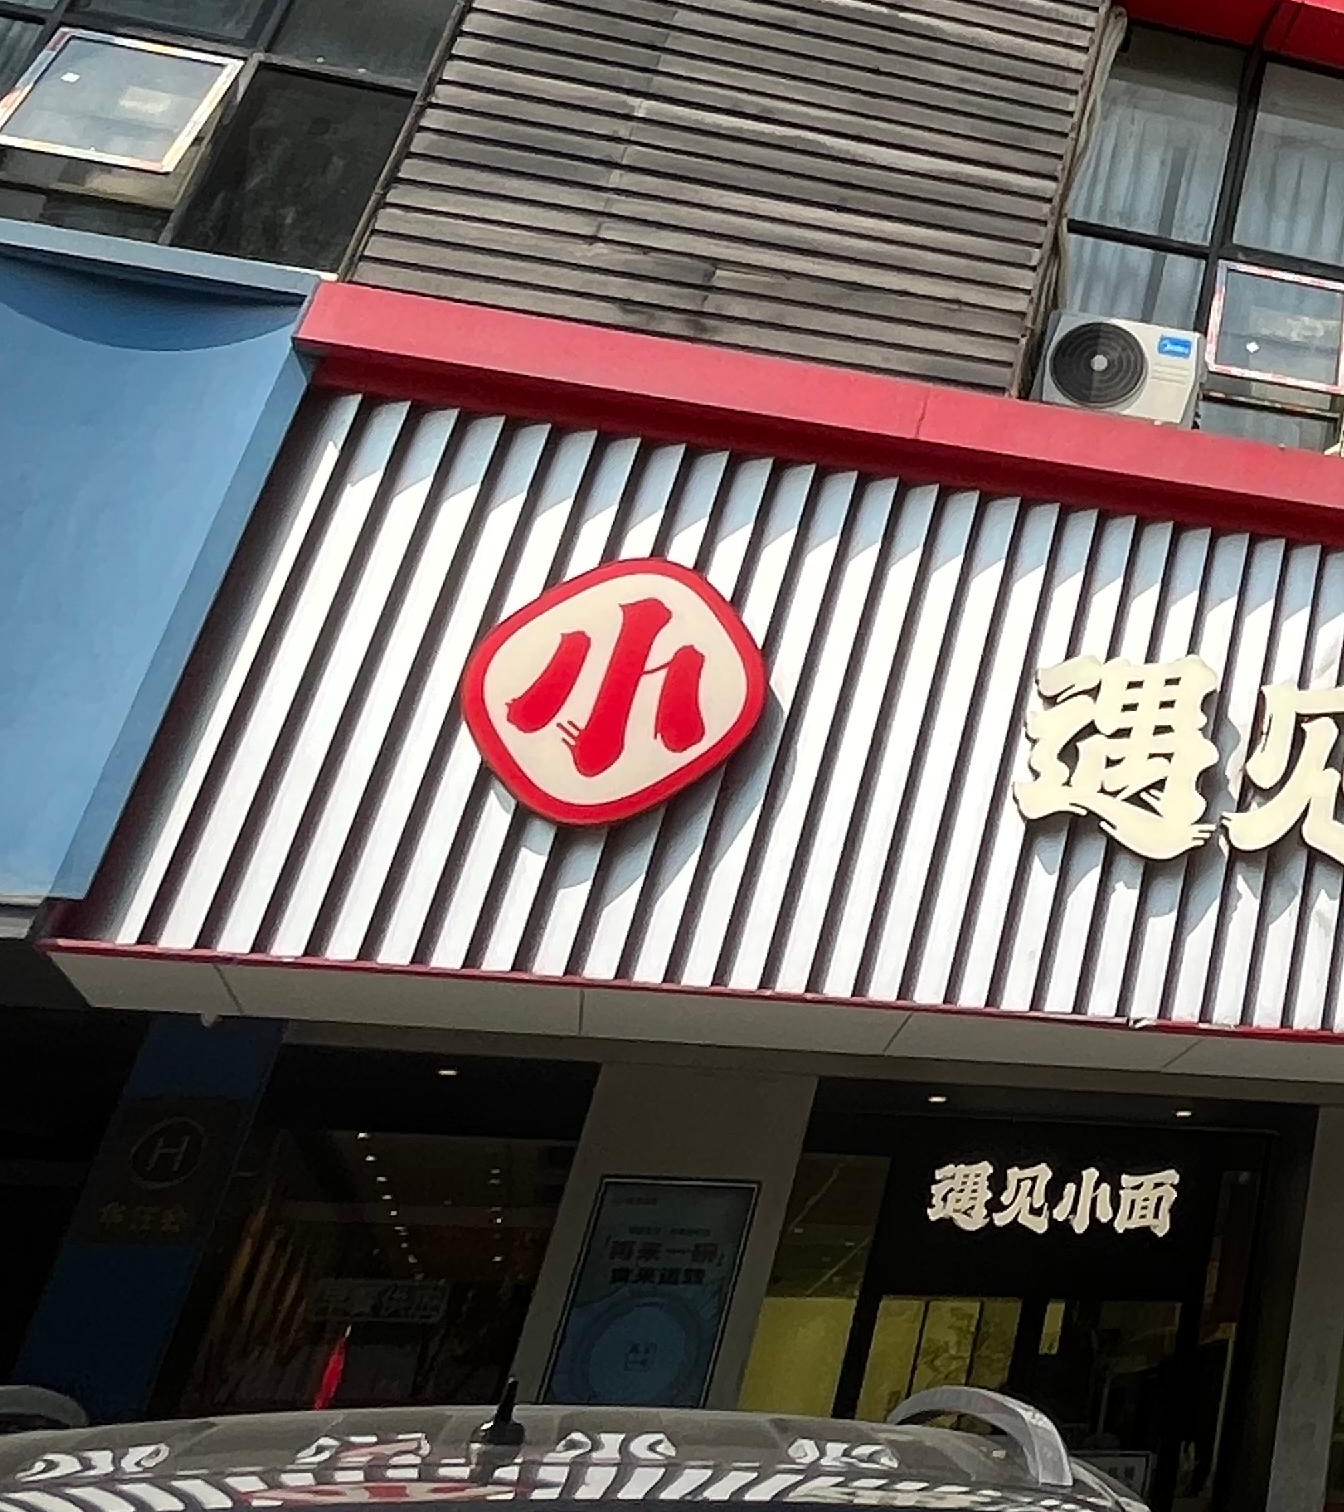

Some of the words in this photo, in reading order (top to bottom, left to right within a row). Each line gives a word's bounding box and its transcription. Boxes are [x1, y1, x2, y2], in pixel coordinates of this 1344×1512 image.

[506, 596, 706, 779] 小
[926, 1161, 1181, 1238] 遇见小面
